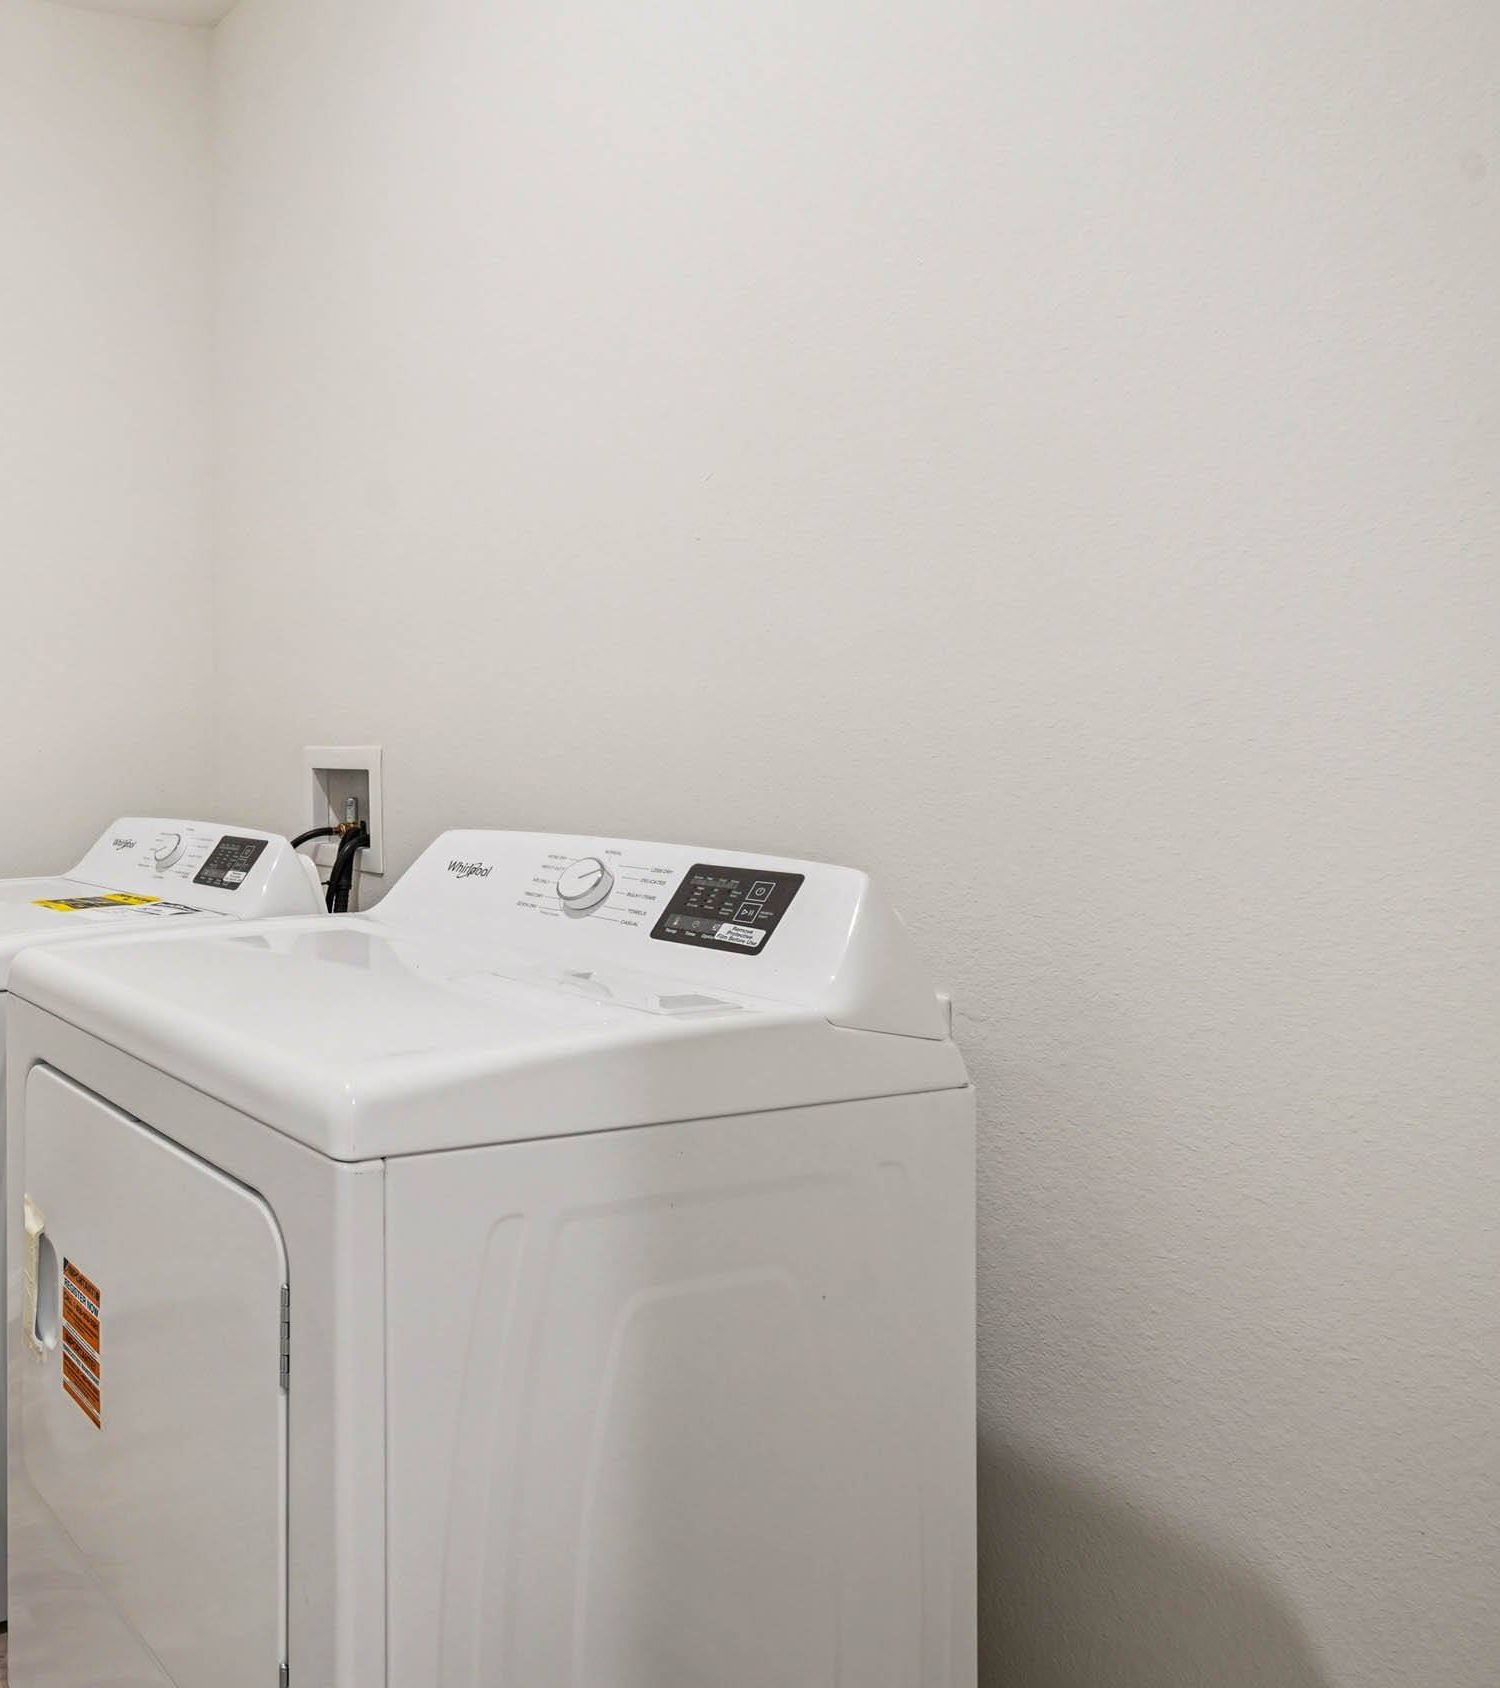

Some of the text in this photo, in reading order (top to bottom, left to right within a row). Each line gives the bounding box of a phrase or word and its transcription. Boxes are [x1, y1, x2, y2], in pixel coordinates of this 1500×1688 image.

[447, 860, 493, 879] Whirlpool
[726, 930, 753, 939] Protective
[732, 926, 754, 934] Remove
[729, 935, 746, 943] Before
[64, 1277, 86, 1304] REGISTER
[87, 1299, 99, 1318] NOW
